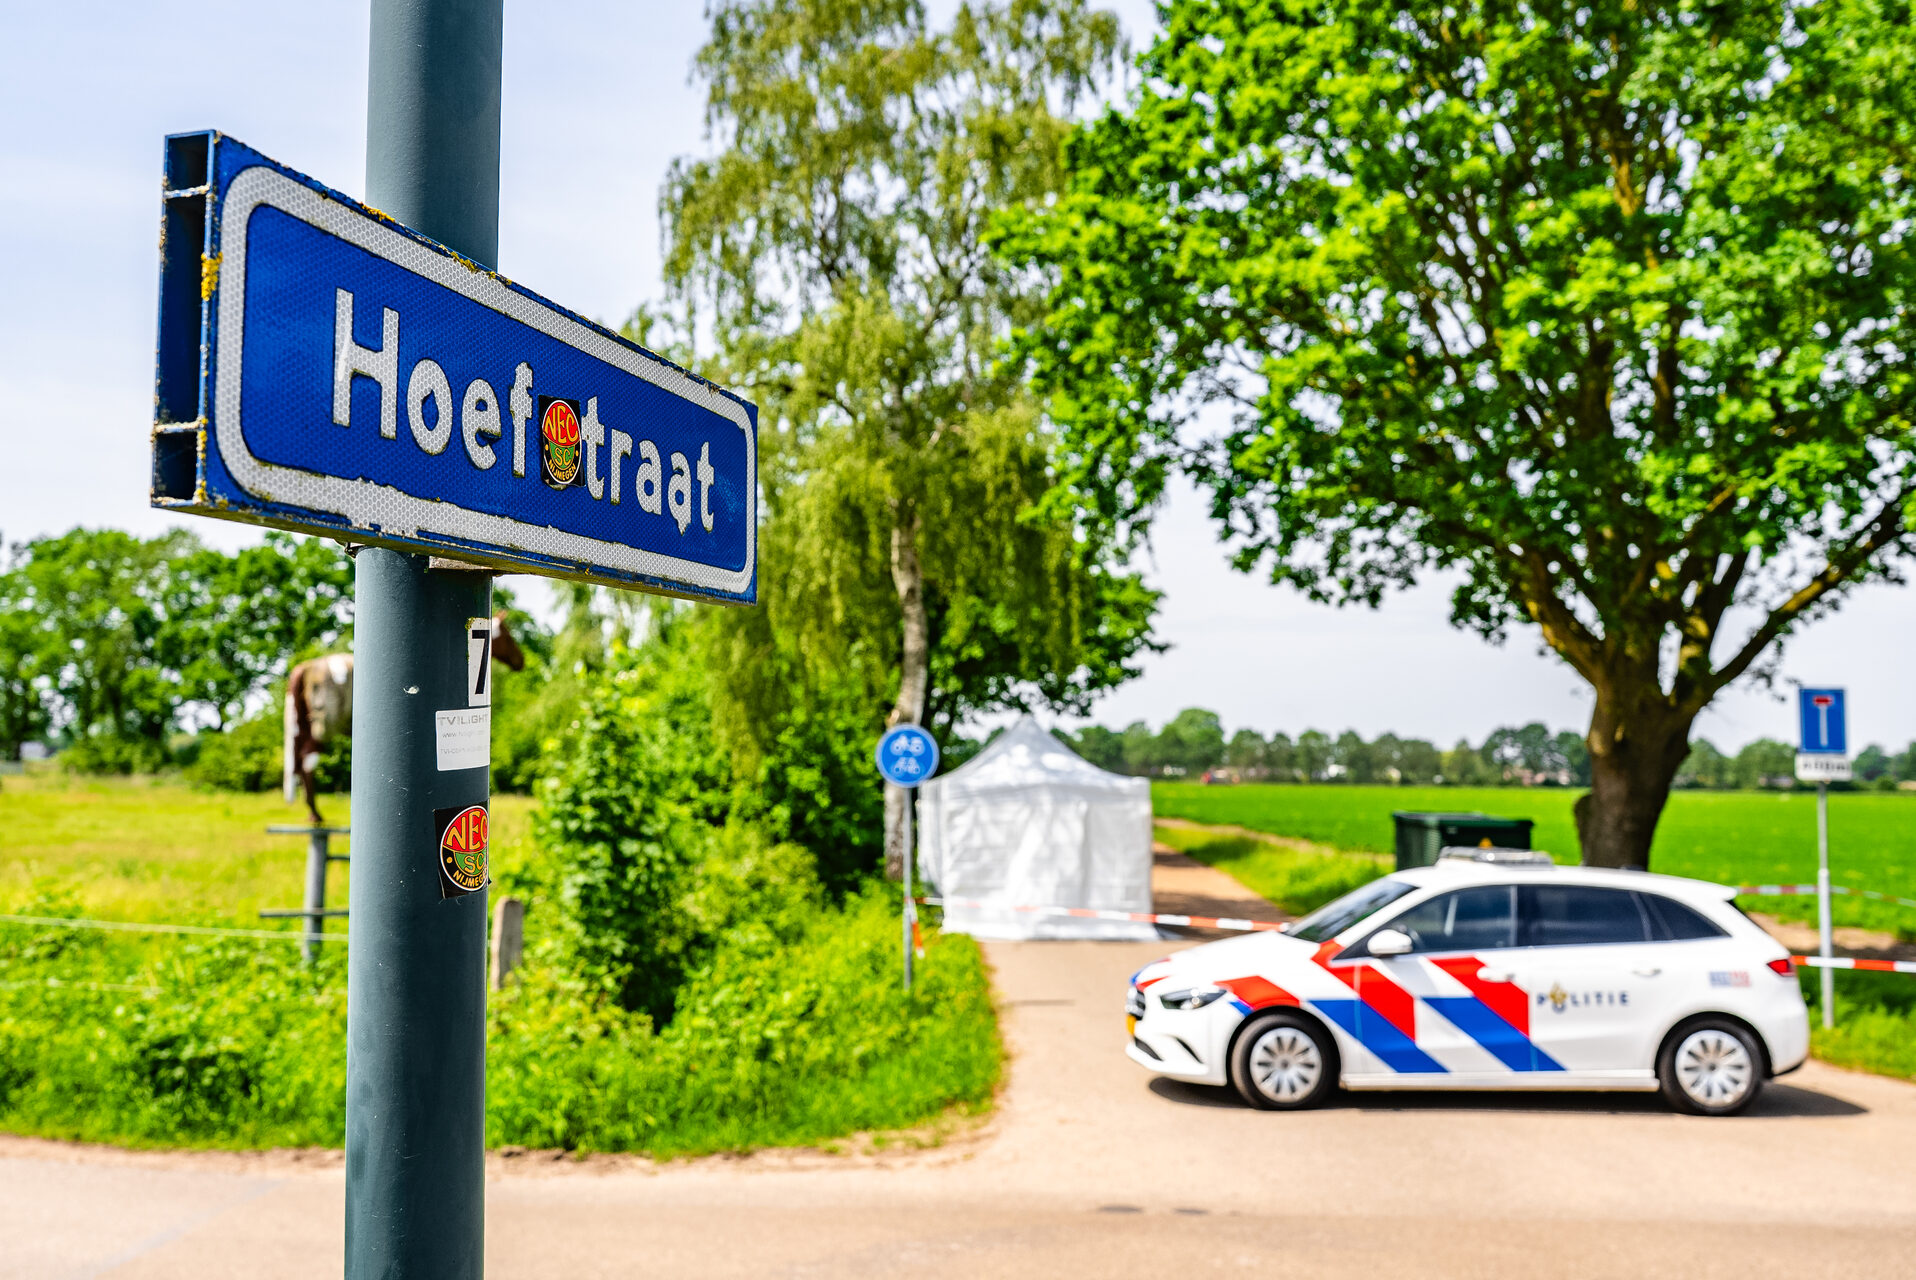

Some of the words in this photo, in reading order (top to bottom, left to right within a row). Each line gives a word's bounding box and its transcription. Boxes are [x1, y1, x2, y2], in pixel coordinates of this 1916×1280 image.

[333, 287, 715, 536] Hoeftraat
[544, 405, 579, 444] NEC
[554, 447, 571, 466] SC
[548, 459, 577, 481] NIJMEGEN
[471, 629, 490, 695] 7
[464, 852, 485, 873] SC
[1537, 990, 1629, 1014] POLITIE
